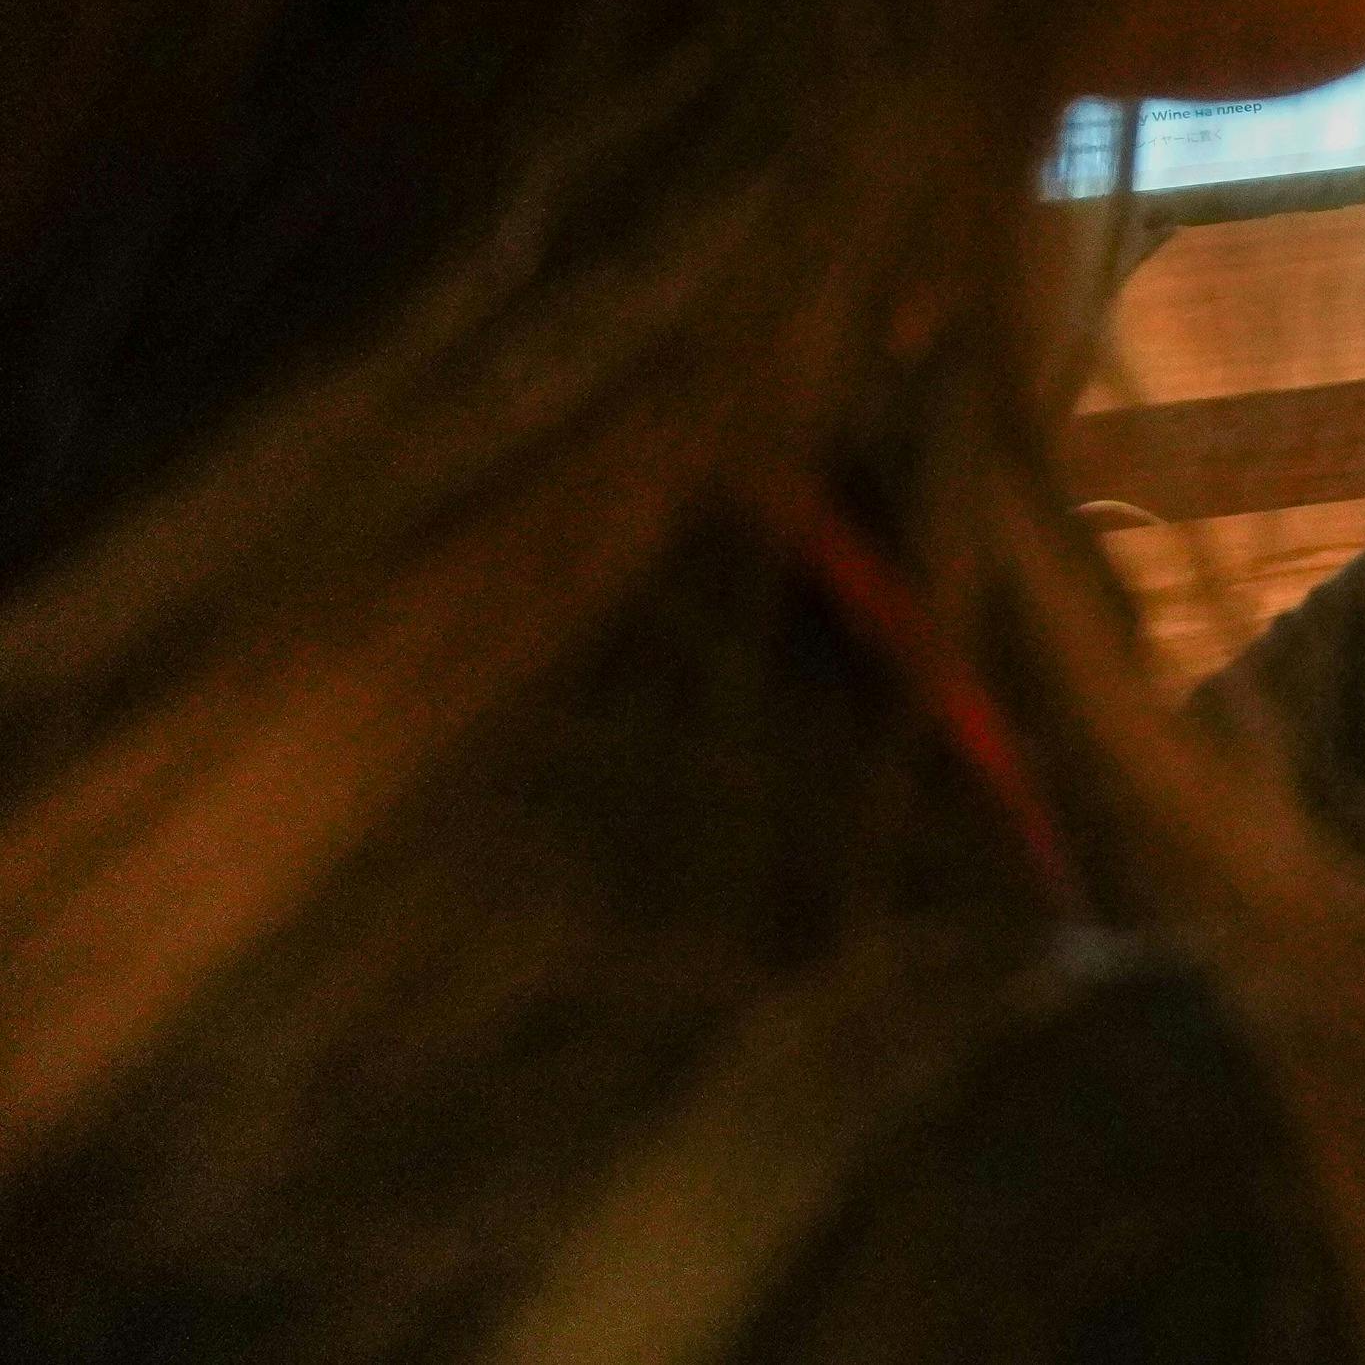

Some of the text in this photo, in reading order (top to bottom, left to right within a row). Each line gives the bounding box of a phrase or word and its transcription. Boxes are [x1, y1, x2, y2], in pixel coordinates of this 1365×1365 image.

[1152, 108, 1192, 122] Wine
[1195, 108, 1213, 118] на
[1217, 102, 1263, 116] плеер
